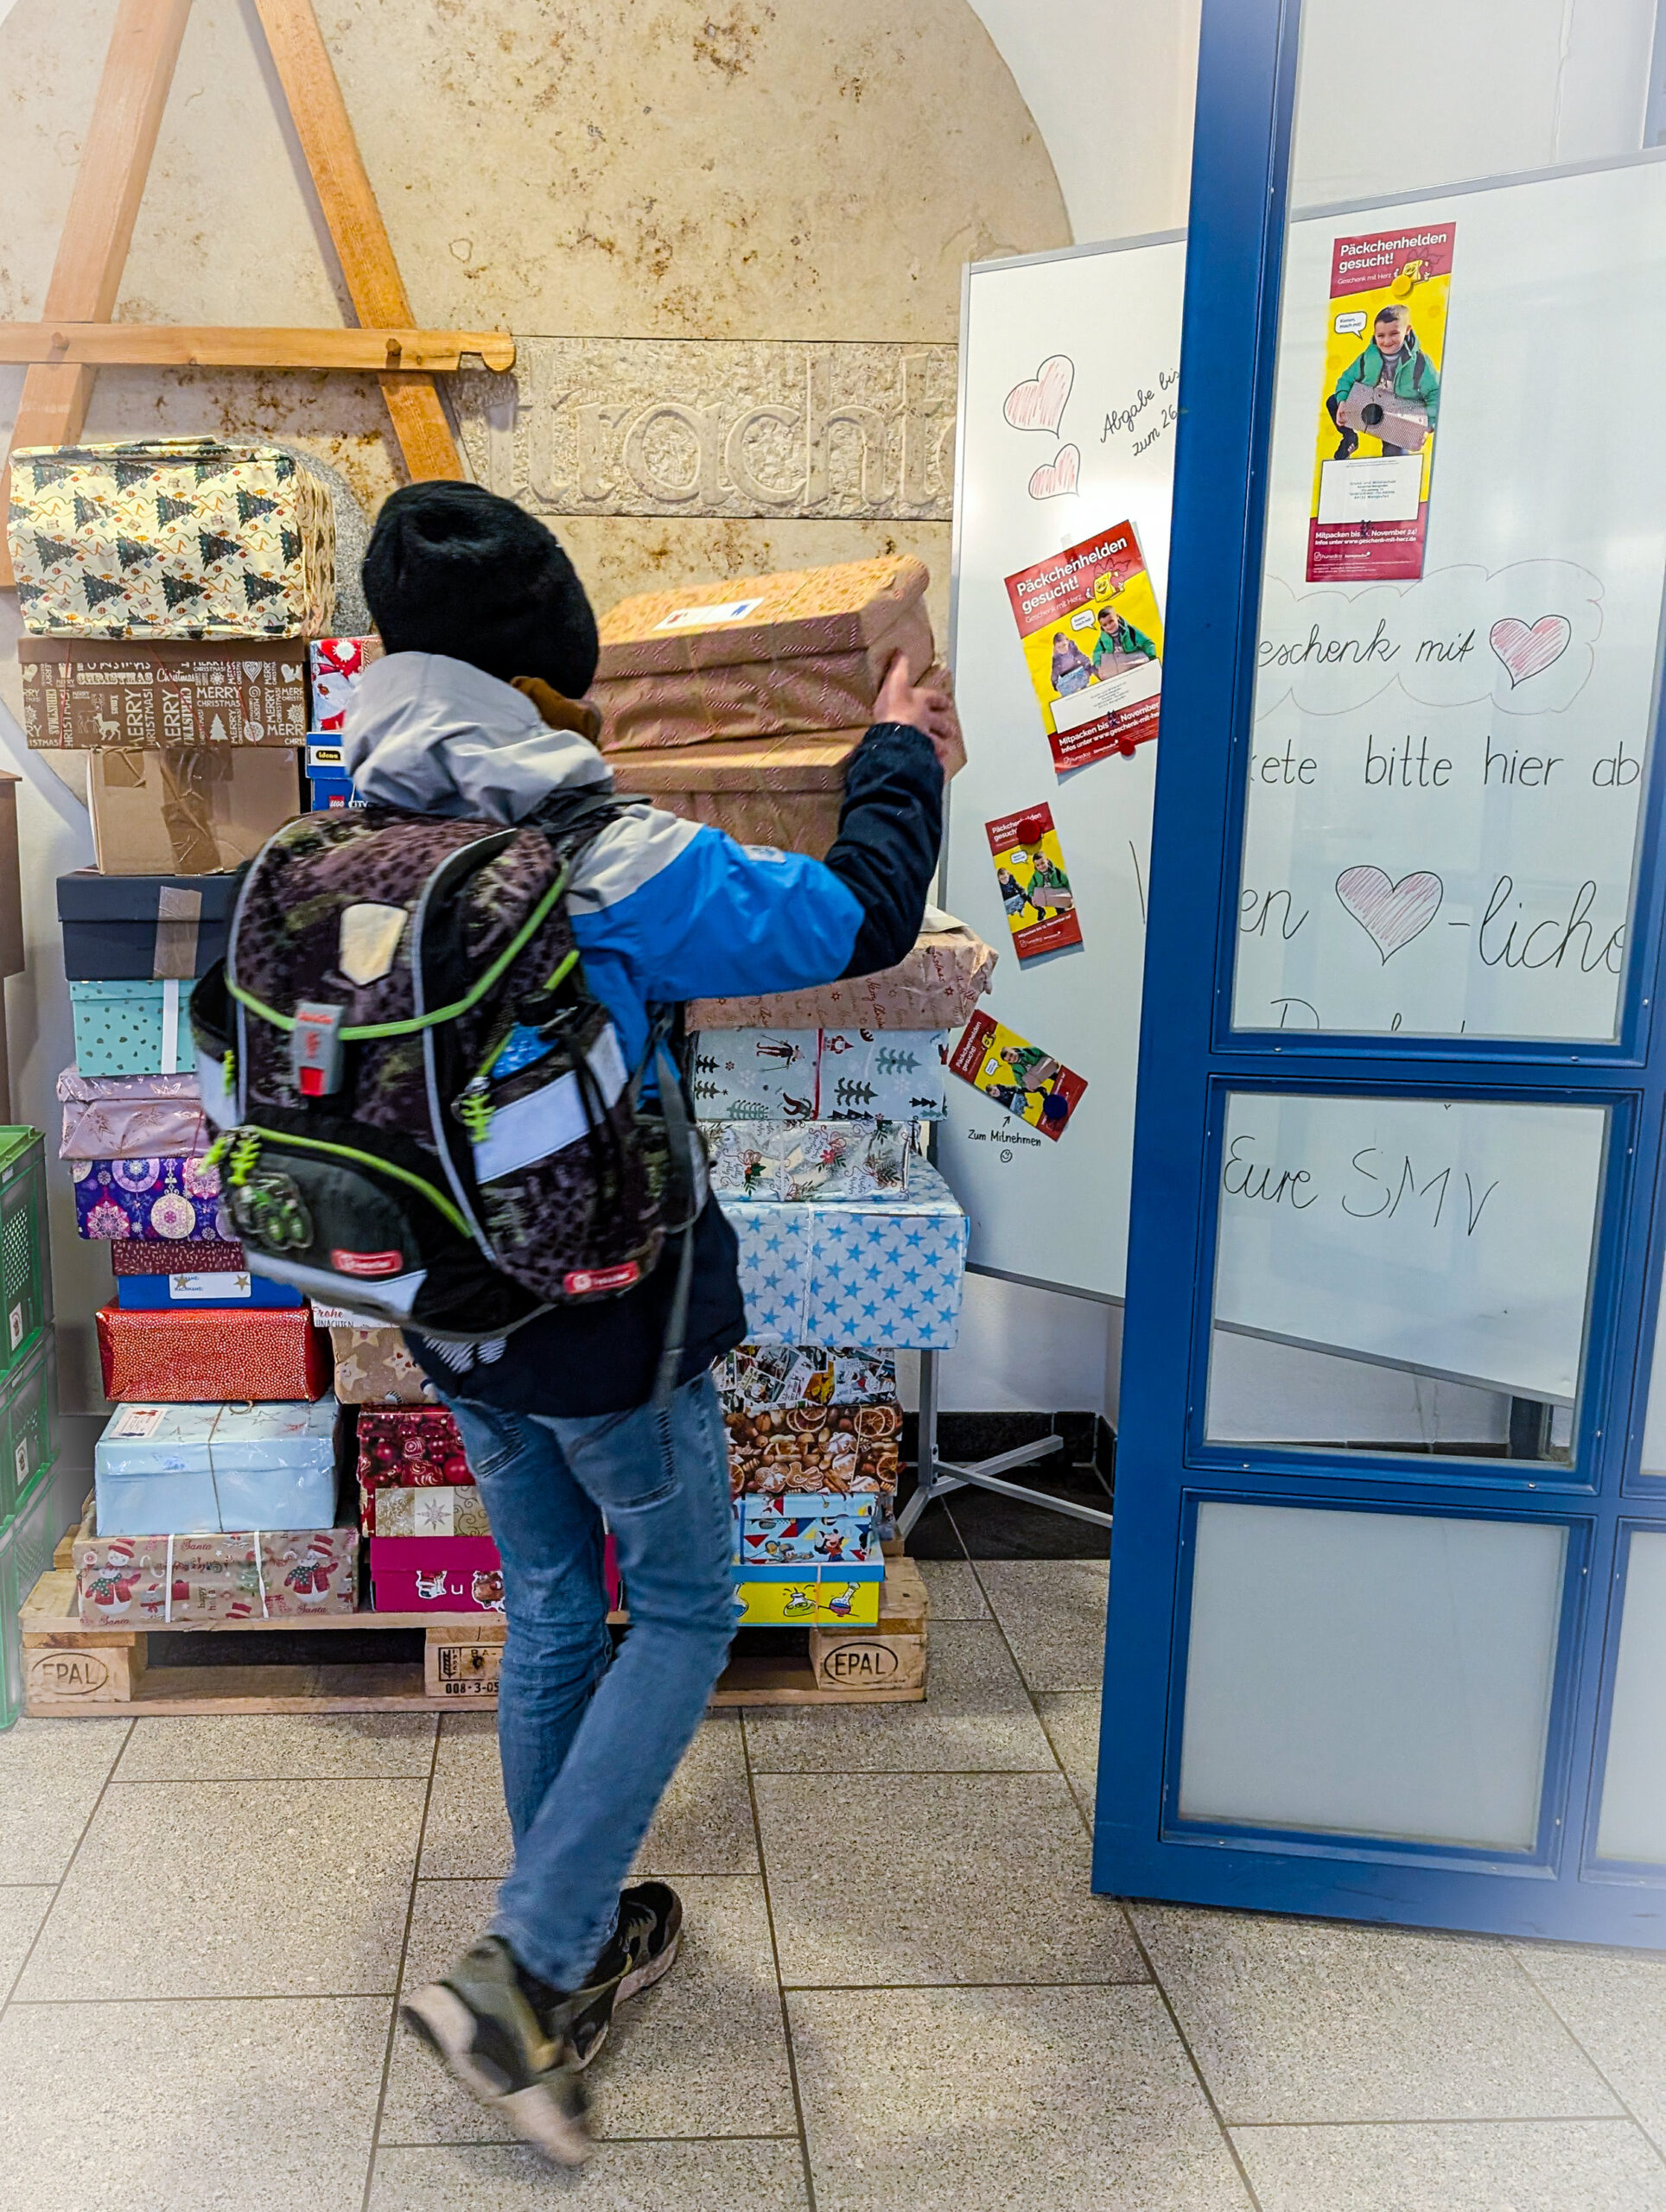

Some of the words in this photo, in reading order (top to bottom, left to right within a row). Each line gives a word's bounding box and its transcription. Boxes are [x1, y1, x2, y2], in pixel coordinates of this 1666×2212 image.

[1340, 232, 1447, 257] Päckchenhelden
[1339, 252, 1394, 274] gesucht!
[1338, 275, 1366, 285] Geschenk
[1100, 389, 1155, 444] Abgabe
[1132, 428, 1160, 457] zum
[1315, 531, 1350, 540] Mitpacken
[1016, 536, 1128, 597] Päckchenhelden
[1022, 575, 1080, 614] gesucht!
[1025, 604, 1056, 624] Geschenk
[1415, 628, 1477, 664] mit
[76, 672, 154, 685] CHRISTMAS
[197, 686, 242, 700] MERRY
[264, 688, 277, 723] MERRY
[229, 709, 238, 744] MERRY
[1059, 728, 1097, 747] Mitpacken
[1097, 721, 1110, 732] bis
[1120, 702, 1160, 722] November
[1060, 744, 1077, 754] Infos
[1077, 737, 1093, 748] unter
[1250, 739, 1318, 785] ete
[1365, 734, 1453, 787] bitte
[1484, 734, 1565, 787] hier
[1593, 741, 1640, 787] ab
[955, 1020, 982, 1068] Päckchenhelden
[962, 1046, 977, 1072] gesucht!
[968, 1128, 987, 1141] Zum
[990, 1129, 1042, 1147] Mitnehmen
[1224, 1135, 1319, 1209] Eure
[1341, 1147, 1500, 1237] SMV
[312, 1306, 345, 1319] Frohe
[835, 1652, 887, 1676] EPAL
